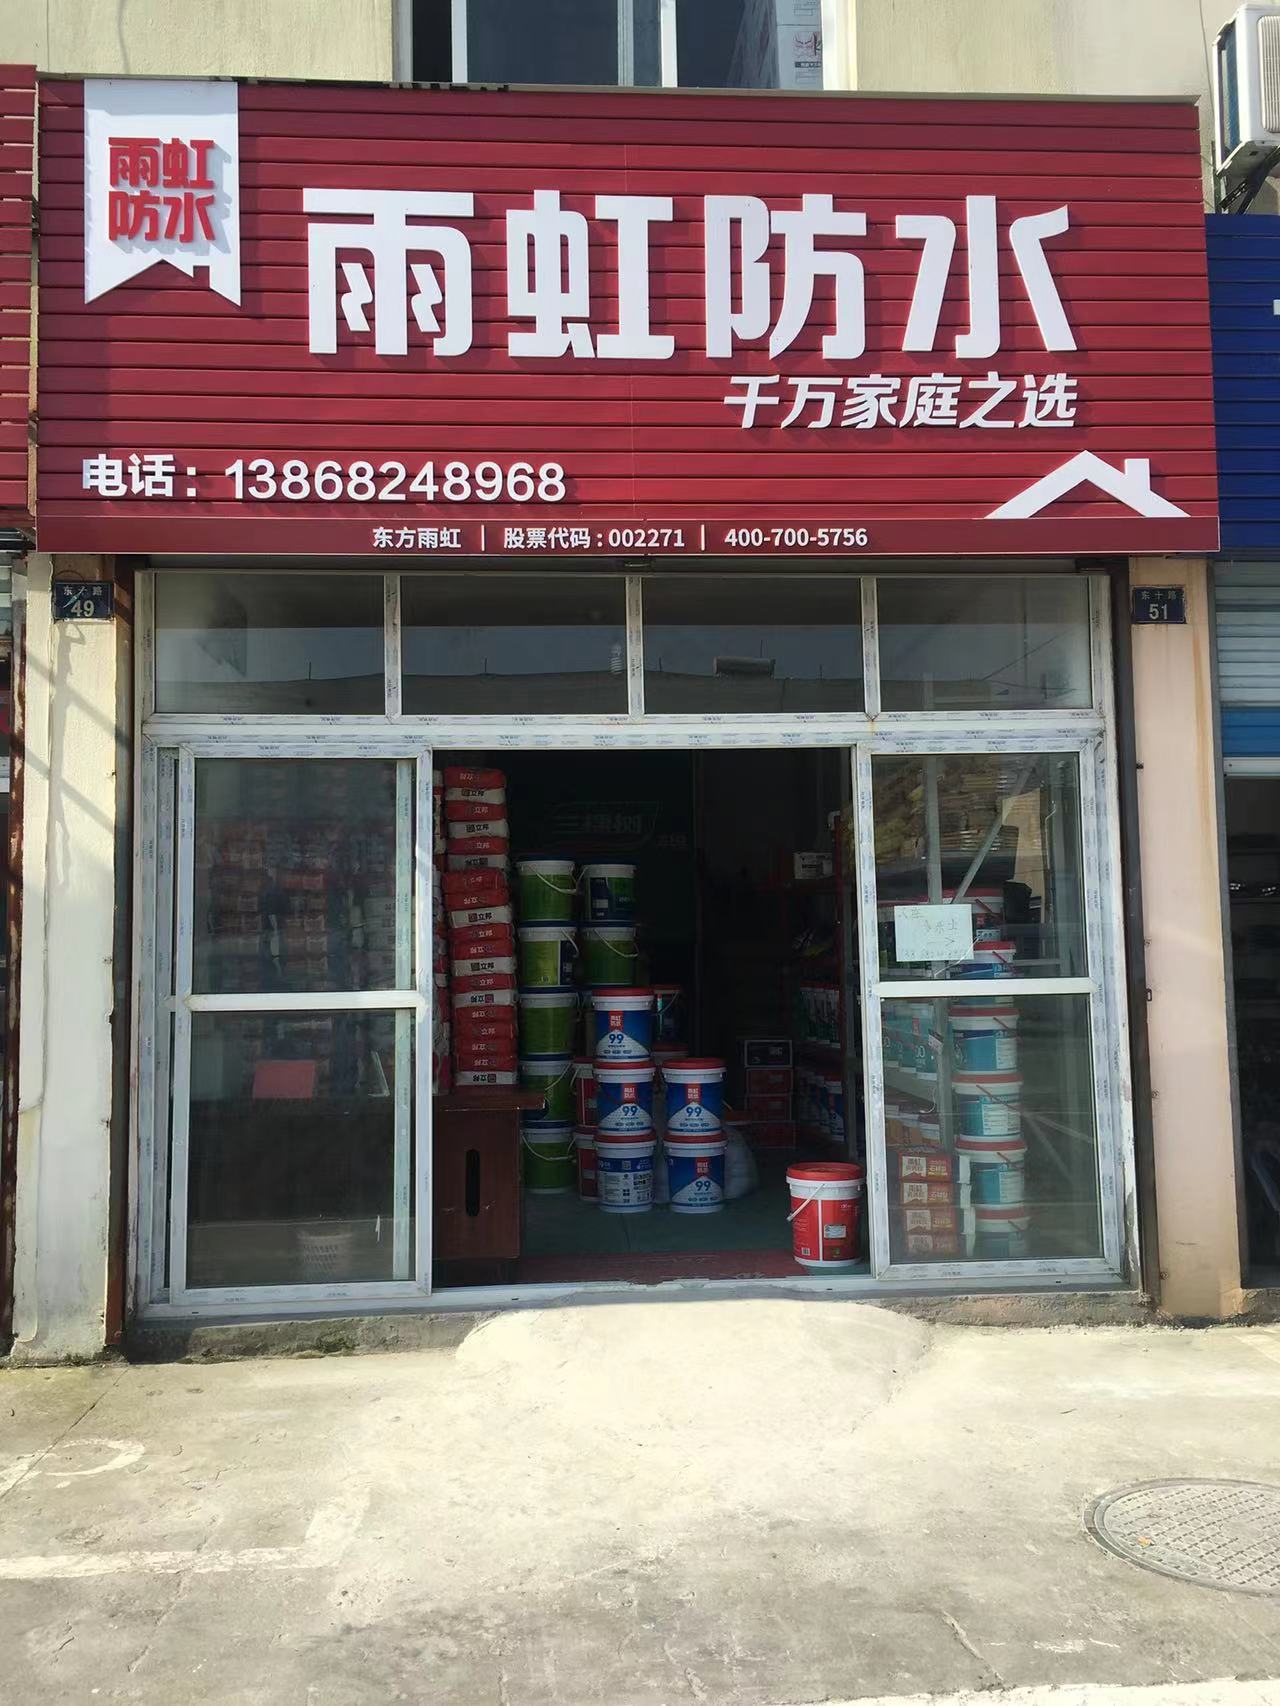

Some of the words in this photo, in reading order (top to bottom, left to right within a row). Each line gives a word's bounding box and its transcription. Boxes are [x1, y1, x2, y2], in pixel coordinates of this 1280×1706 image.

[108, 137, 215, 189] 雨虹
[108, 191, 215, 243] 防水
[303, 188, 1078, 360] 雨虹防水
[723, 371, 1078, 430] 千万家庭之选
[372, 526, 461, 549] 东方雨虹
[724, 527, 869, 549] 400-700-5756
[71, 600, 95, 617] 49
[1149, 603, 1168, 620] 51
[608, 1033, 624, 1044] 99
[621, 1106, 638, 1117] 99
[686, 1106, 702, 1117] 99
[695, 1180, 711, 1191] 99
